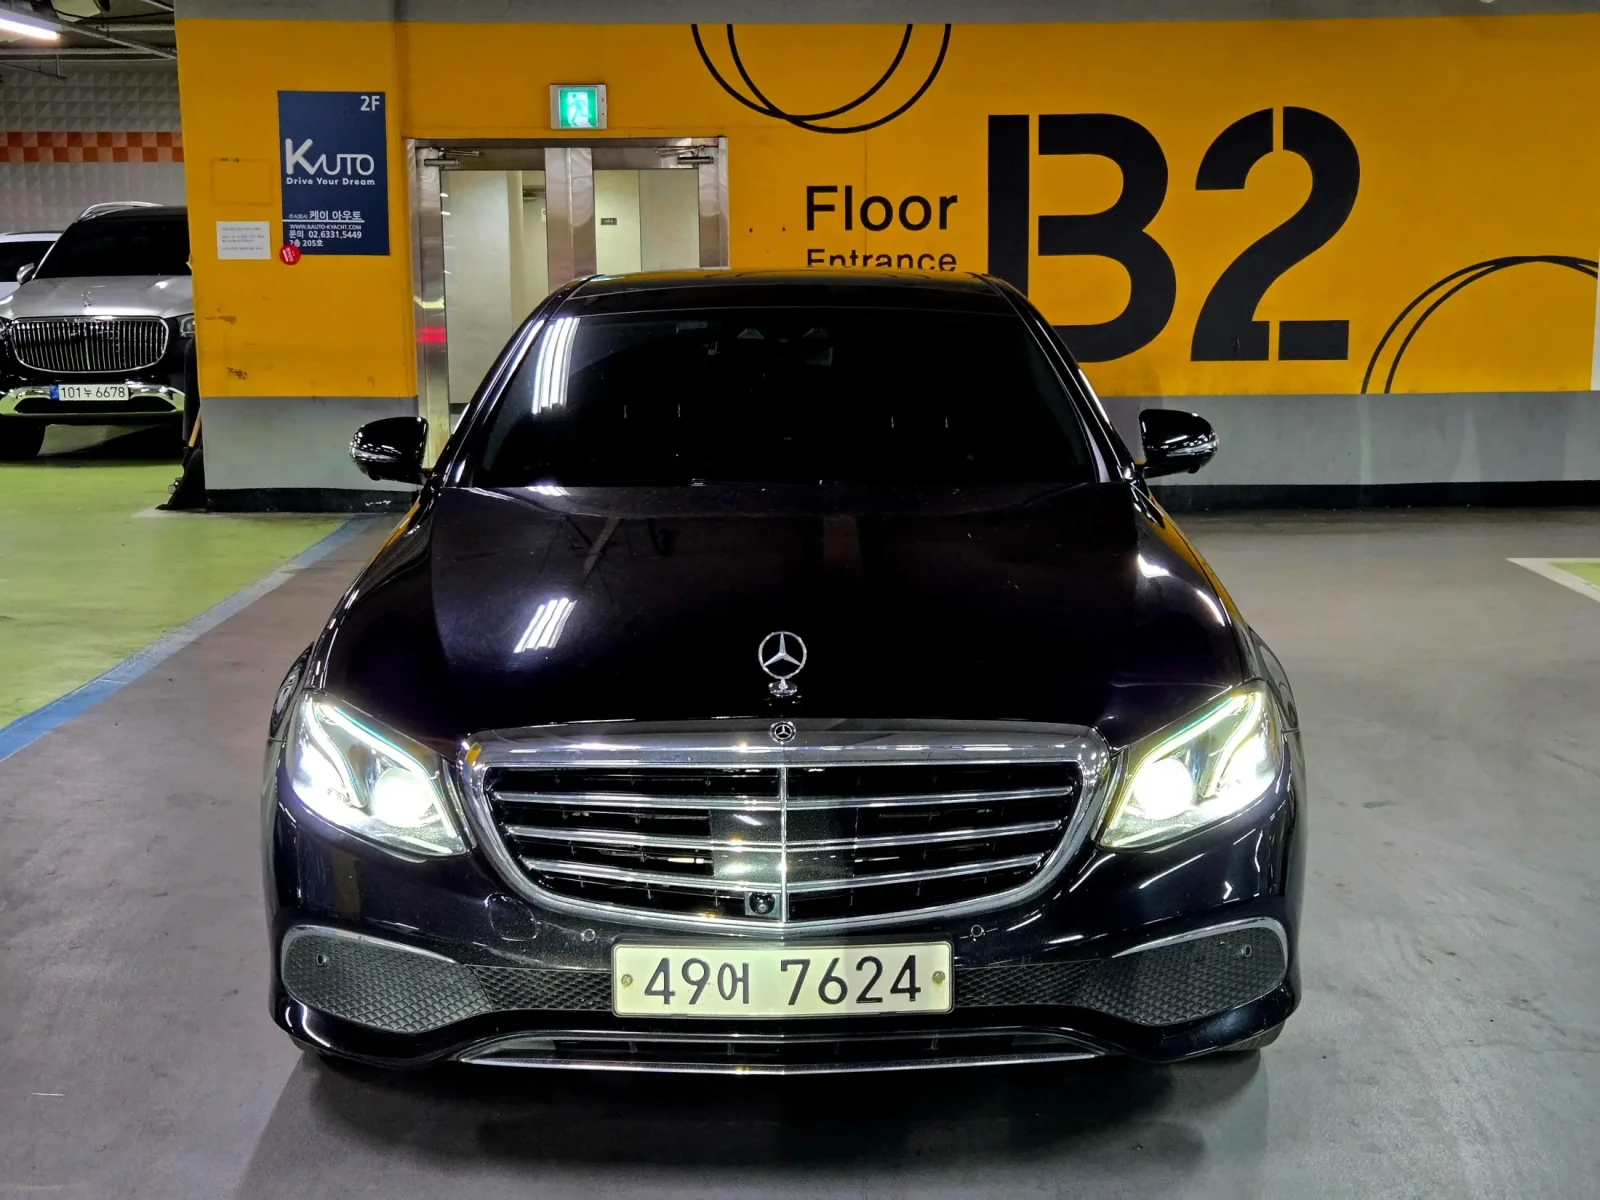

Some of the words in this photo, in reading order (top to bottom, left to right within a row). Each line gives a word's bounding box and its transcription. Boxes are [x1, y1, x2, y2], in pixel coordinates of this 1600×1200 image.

[360, 95, 380, 111] 2F
[286, 177, 314, 185] Drive
[316, 177, 339, 185] Your
[342, 178, 376, 186] Dream
[309, 210, 329, 221] 케이
[332, 210, 363, 221] 아우토
[806, 185, 958, 232] Floor
[289, 230, 304, 239] 문의
[308, 230, 362, 239] 02.6331.5449
[987, 105, 1361, 363] B2
[302, 239, 324, 247] 205호
[807, 248, 957, 272] Entrance
[61, 386, 93, 399] 101누
[95, 386, 126, 399] 6678
[644, 956, 750, 1005] 49어
[780, 954, 922, 1006] 7624
